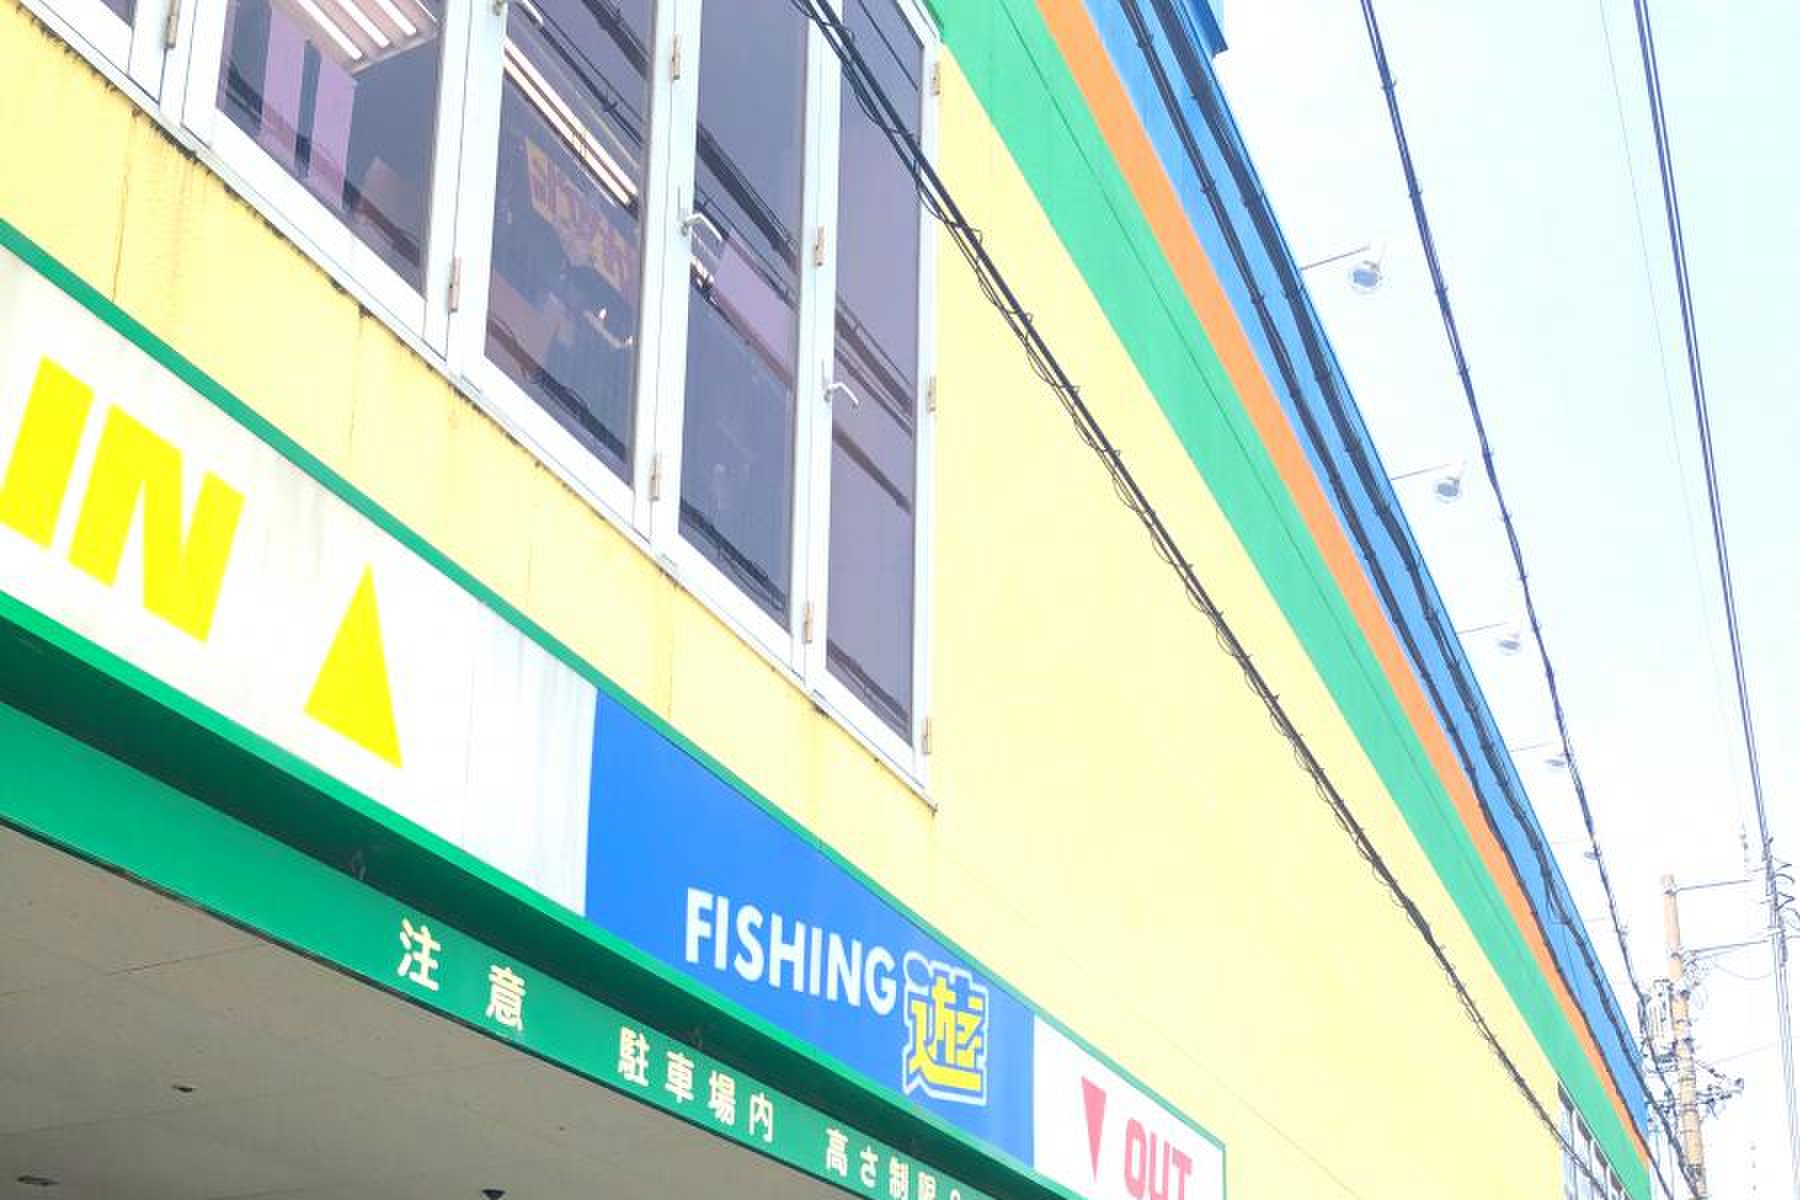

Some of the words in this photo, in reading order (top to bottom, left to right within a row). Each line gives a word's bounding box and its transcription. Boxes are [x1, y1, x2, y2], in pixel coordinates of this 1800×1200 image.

[0, 355, 246, 643] IN
[617, 1026, 775, 1143] 駐車場内
[685, 886, 897, 1016] FISHING
[903, 950, 990, 1106] 遊
